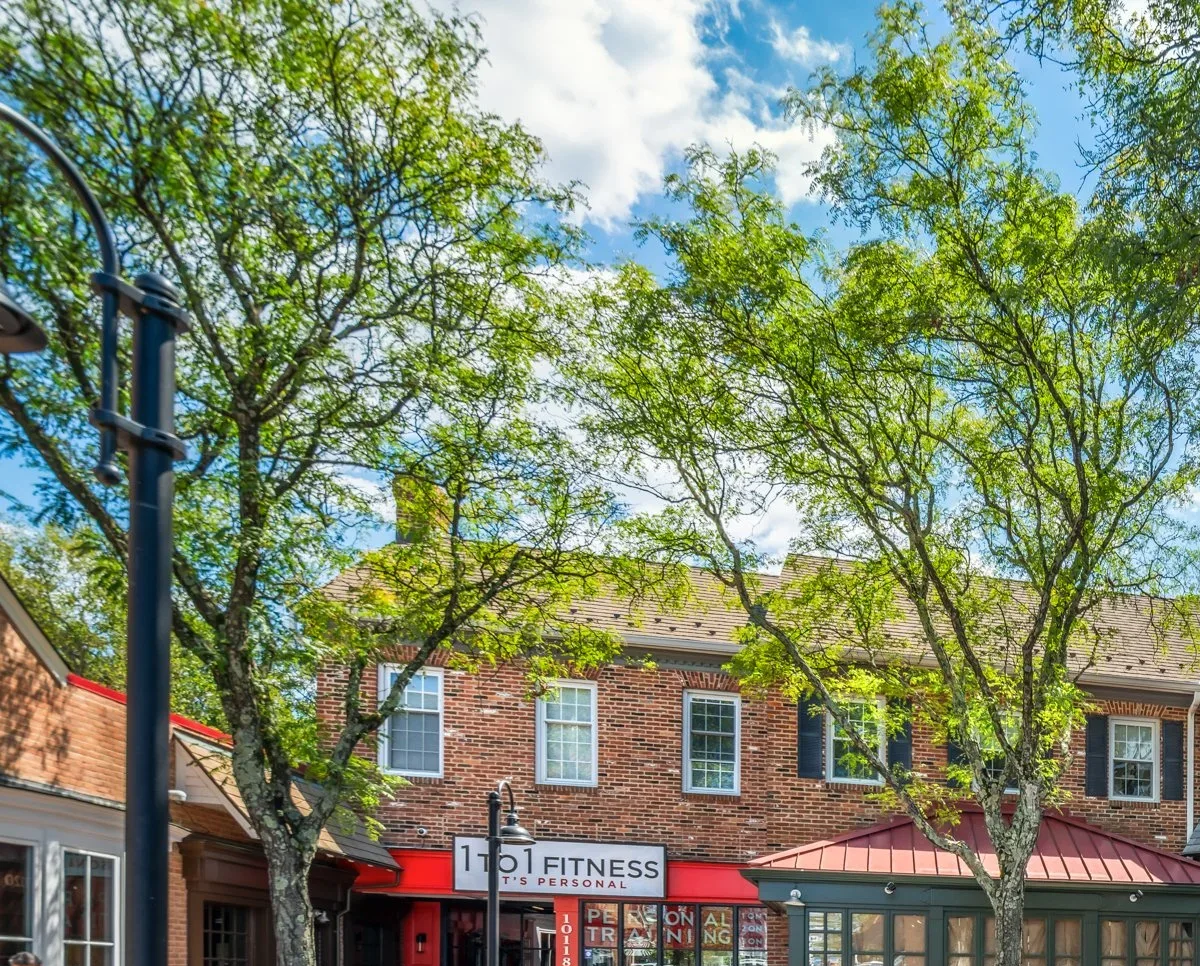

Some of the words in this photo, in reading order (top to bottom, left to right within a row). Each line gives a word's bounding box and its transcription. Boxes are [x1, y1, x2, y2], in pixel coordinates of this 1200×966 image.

[461, 845, 470, 871] 1
[524, 848, 532, 874] 1
[544, 856, 659, 879] FITNESS
[502, 876, 528, 886] T'S
[538, 877, 627, 889] PERSONAL
[561, 914, 573, 966] 10118
